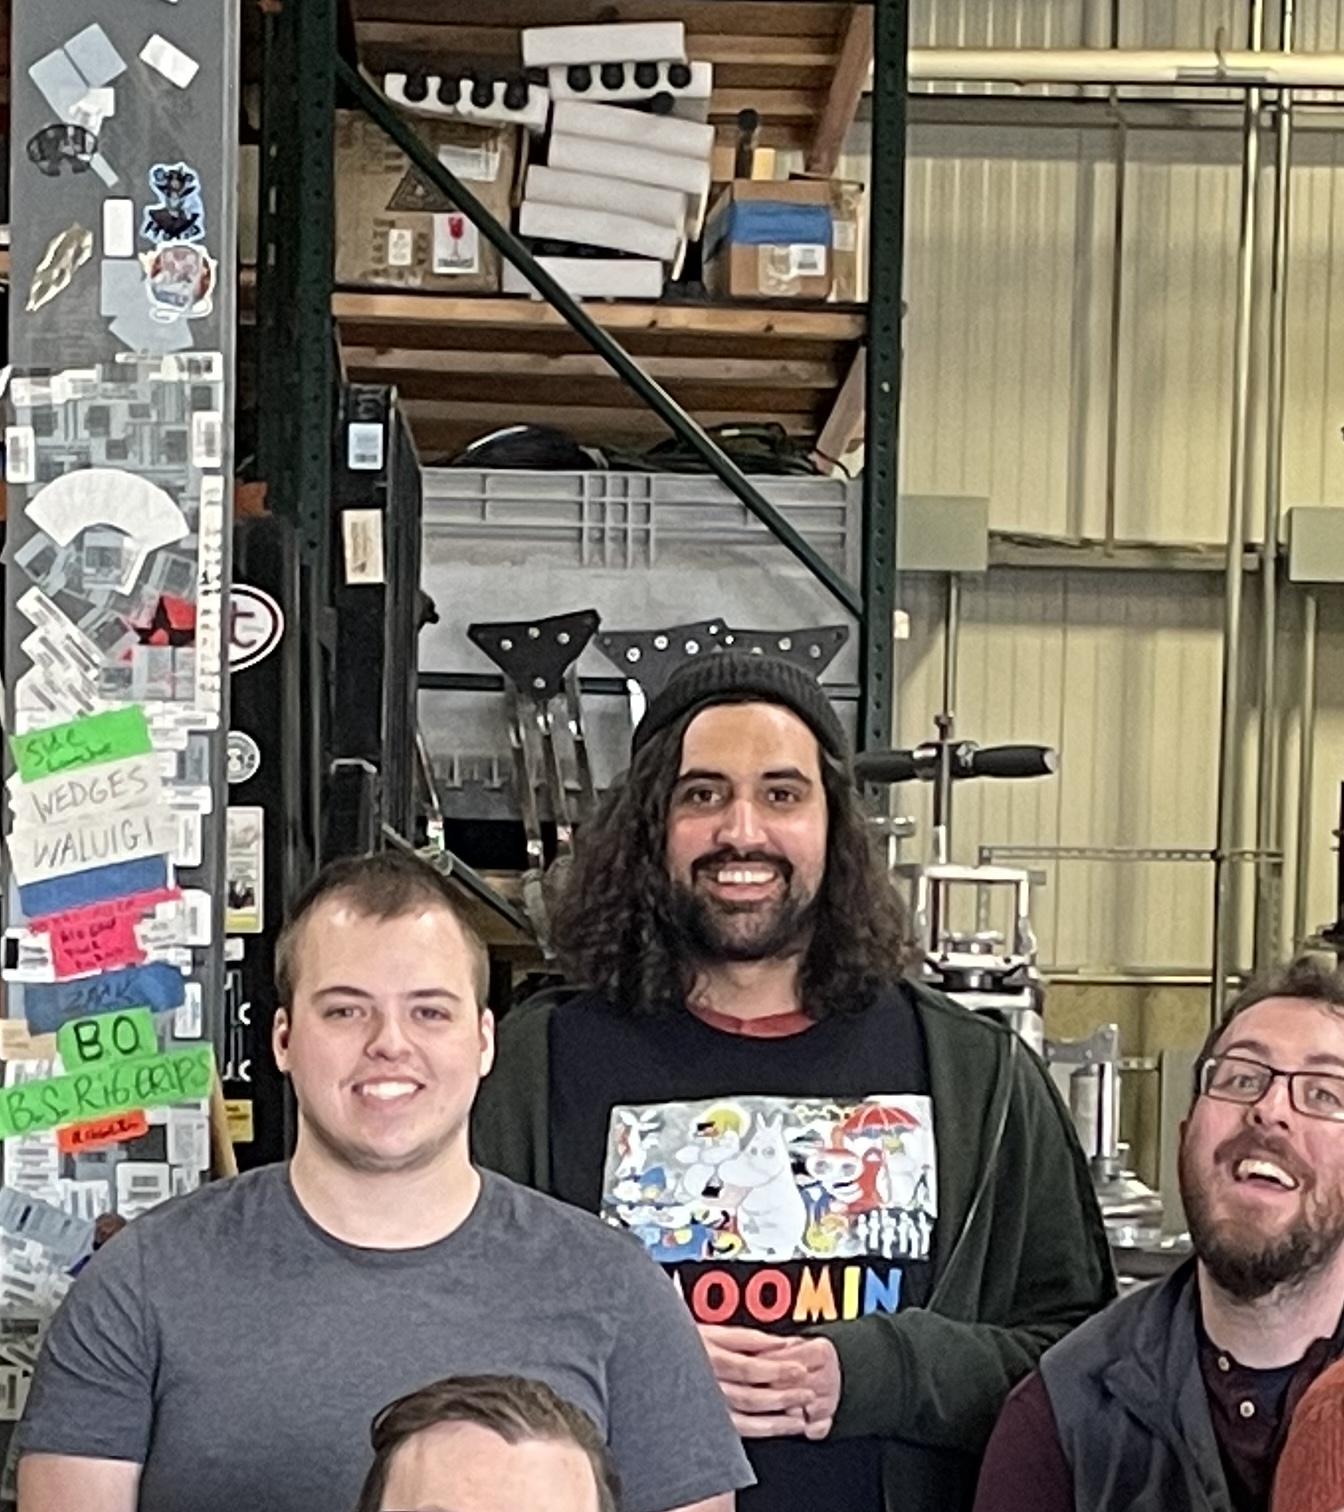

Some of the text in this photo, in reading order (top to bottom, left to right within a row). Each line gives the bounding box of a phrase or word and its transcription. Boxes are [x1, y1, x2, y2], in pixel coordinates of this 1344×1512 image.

[32, 766, 148, 823] WEDGES
[34, 816, 154, 868] WALUIGI
[673, 1265, 902, 1322] OOMIN
